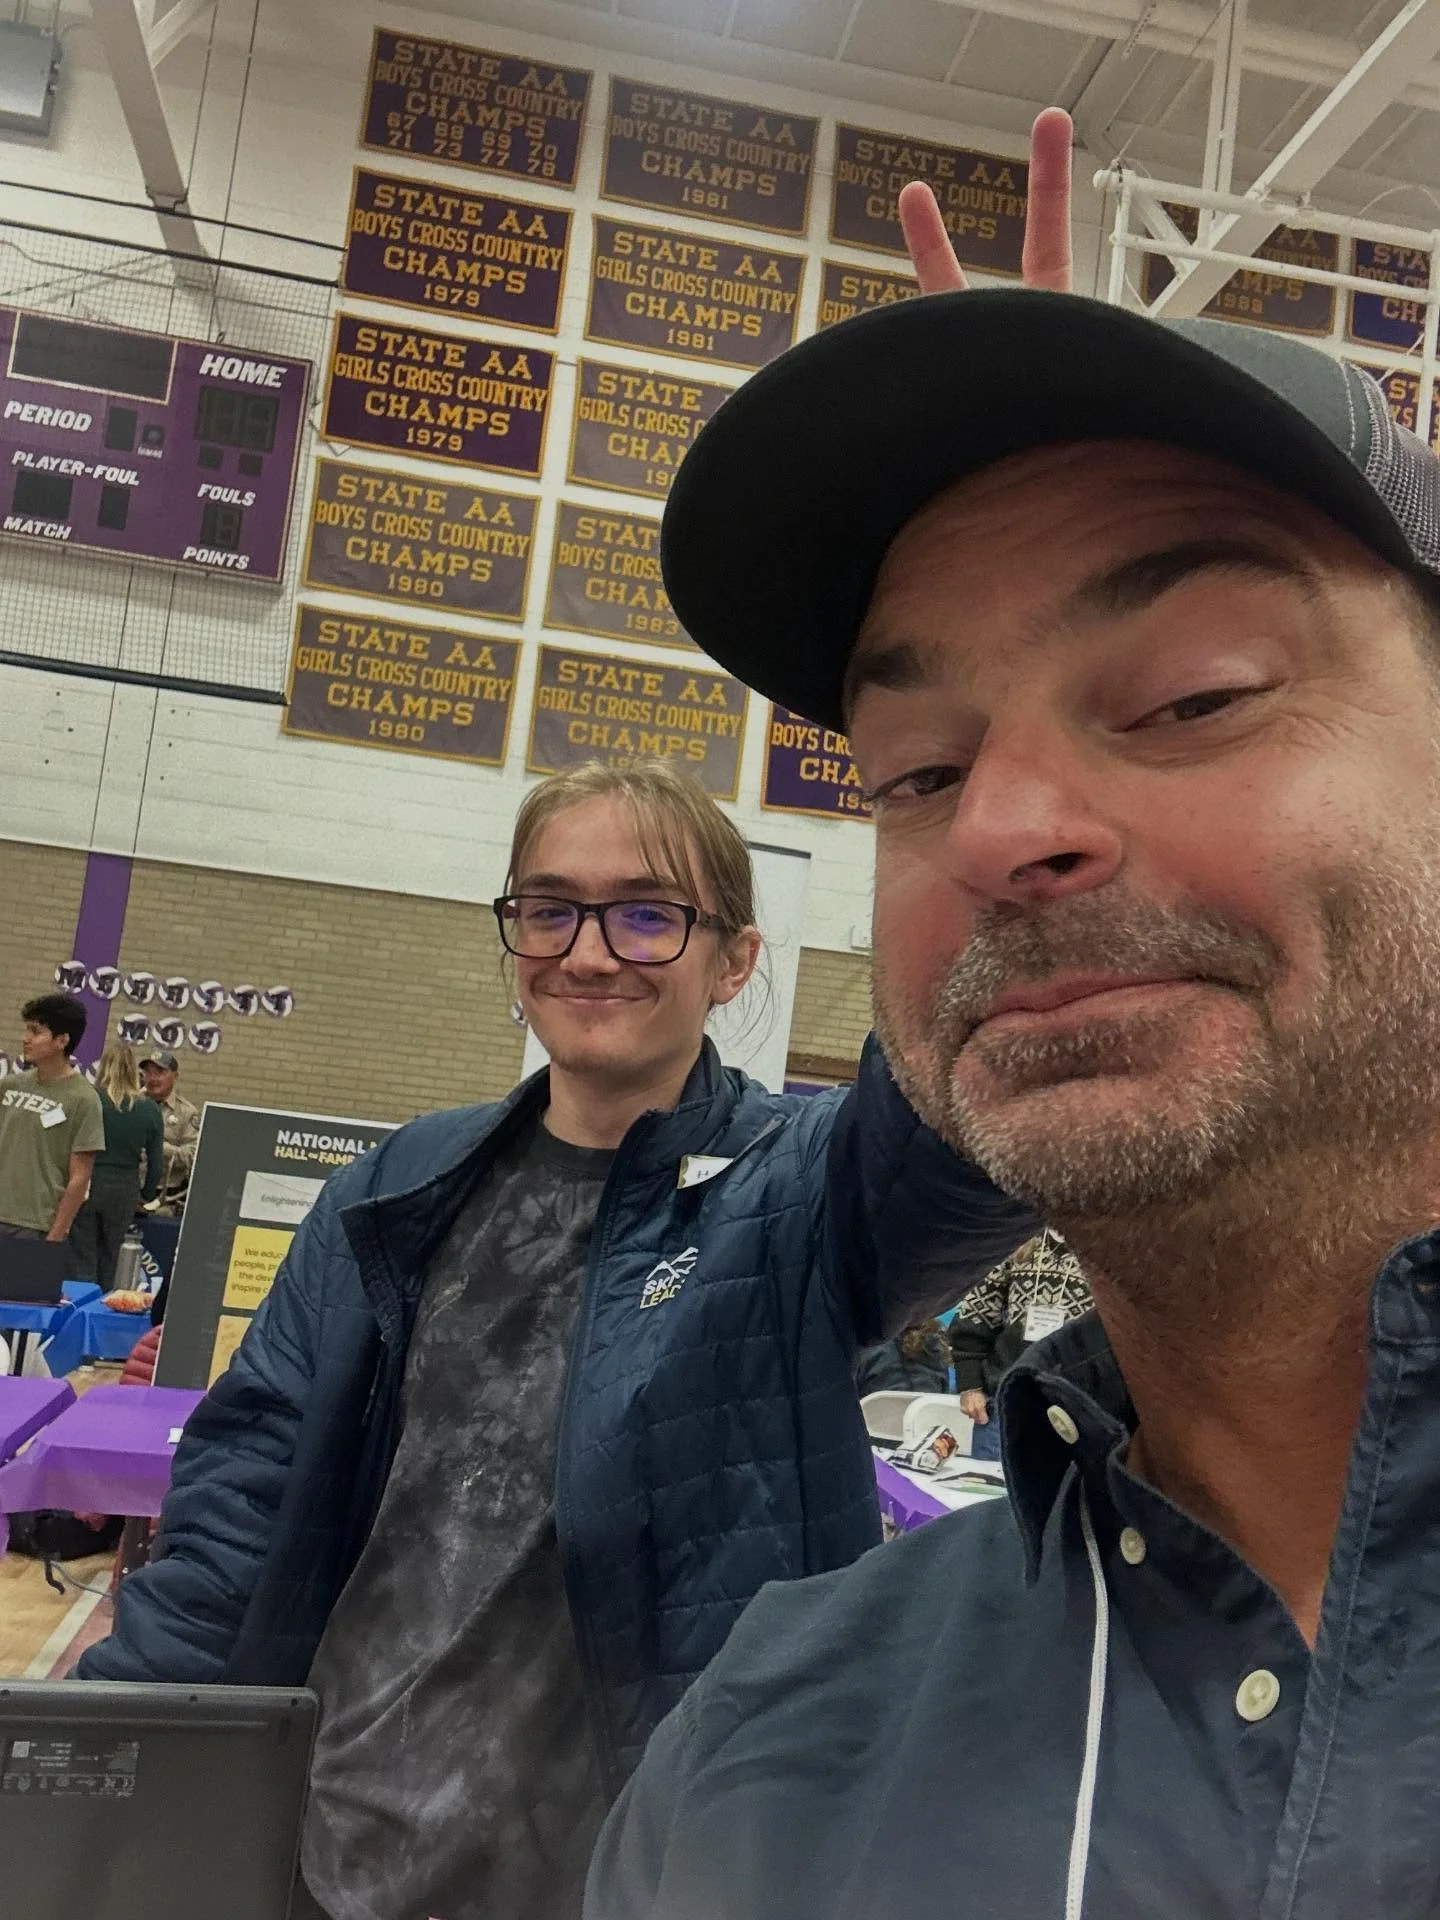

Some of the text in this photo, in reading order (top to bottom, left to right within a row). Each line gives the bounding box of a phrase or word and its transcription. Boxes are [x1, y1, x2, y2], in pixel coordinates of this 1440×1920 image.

[394, 40, 568, 97] STATE AA
[375, 60, 584, 121] BOYS CROSS COUNTRY
[405, 91, 547, 139] CHAMPS
[629, 92, 796, 146] STATE AA
[389, 130, 555, 177] 71 73 77 78
[528, 140, 558, 161] 70
[612, 115, 811, 174] BOYS CROSS COUNTRY
[856, 140, 957, 178] STATE
[969, 162, 1016, 190] AA
[641, 150, 777, 197] CHAMPS
[839, 160, 884, 189] BOYS
[373, 184, 549, 240] STATE AA
[682, 186, 729, 210] 1981
[352, 208, 563, 271] BOYS CROSS COUNTRY
[613, 231, 782, 283] STATE AA
[383, 246, 528, 295] CHAMPS
[596, 256, 797, 314] GIRLS CROSS COUNTRY
[424, 283, 480, 308] 1979
[625, 292, 762, 337] CHAMPS
[356, 327, 532, 381] STATE AA
[666, 328, 714, 351] 1981
[199, 353, 288, 389] HOME
[334, 352, 548, 412] GIRLS CROSS COUNTRY
[597, 371, 703, 412] STATE
[4, 400, 93, 432] PERIOD
[364, 391, 512, 436] CHAMPS
[579, 397, 630, 428] GIRLS
[633, 407, 691, 439] CROSS
[406, 427, 464, 452] 1979
[12, 450, 140, 486] PLAYER-FOUL
[198, 483, 256, 507] FOULS
[336, 473, 515, 526] STATE AA
[3, 516, 72, 541] MATCH
[315, 500, 531, 558] BOYS CROSS COUNTRY
[183, 546, 250, 570] POINTS
[345, 537, 494, 582] CHAMPS
[558, 541, 608, 571] BOYS
[387, 573, 444, 597] 1980
[318, 620, 496, 671] STATE AA
[297, 647, 512, 701] GIRLS CROSS COUNTRY
[558, 660, 727, 707] STATE AA
[327, 683, 475, 726] CHAMPS
[538, 686, 743, 738] GIRLS CROSS COUNTRY
[369, 719, 425, 742] 1980
[567, 720, 708, 762] CHAMPS
[771, 722, 820, 752] BOYS
[275, 1145, 307, 1161] HALL
[277, 1129, 366, 1154] NATIONAL
[231, 1284, 261, 1295] inspire
[239, 1271, 254, 1280] the
[643, 1275, 675, 1296] SKI
